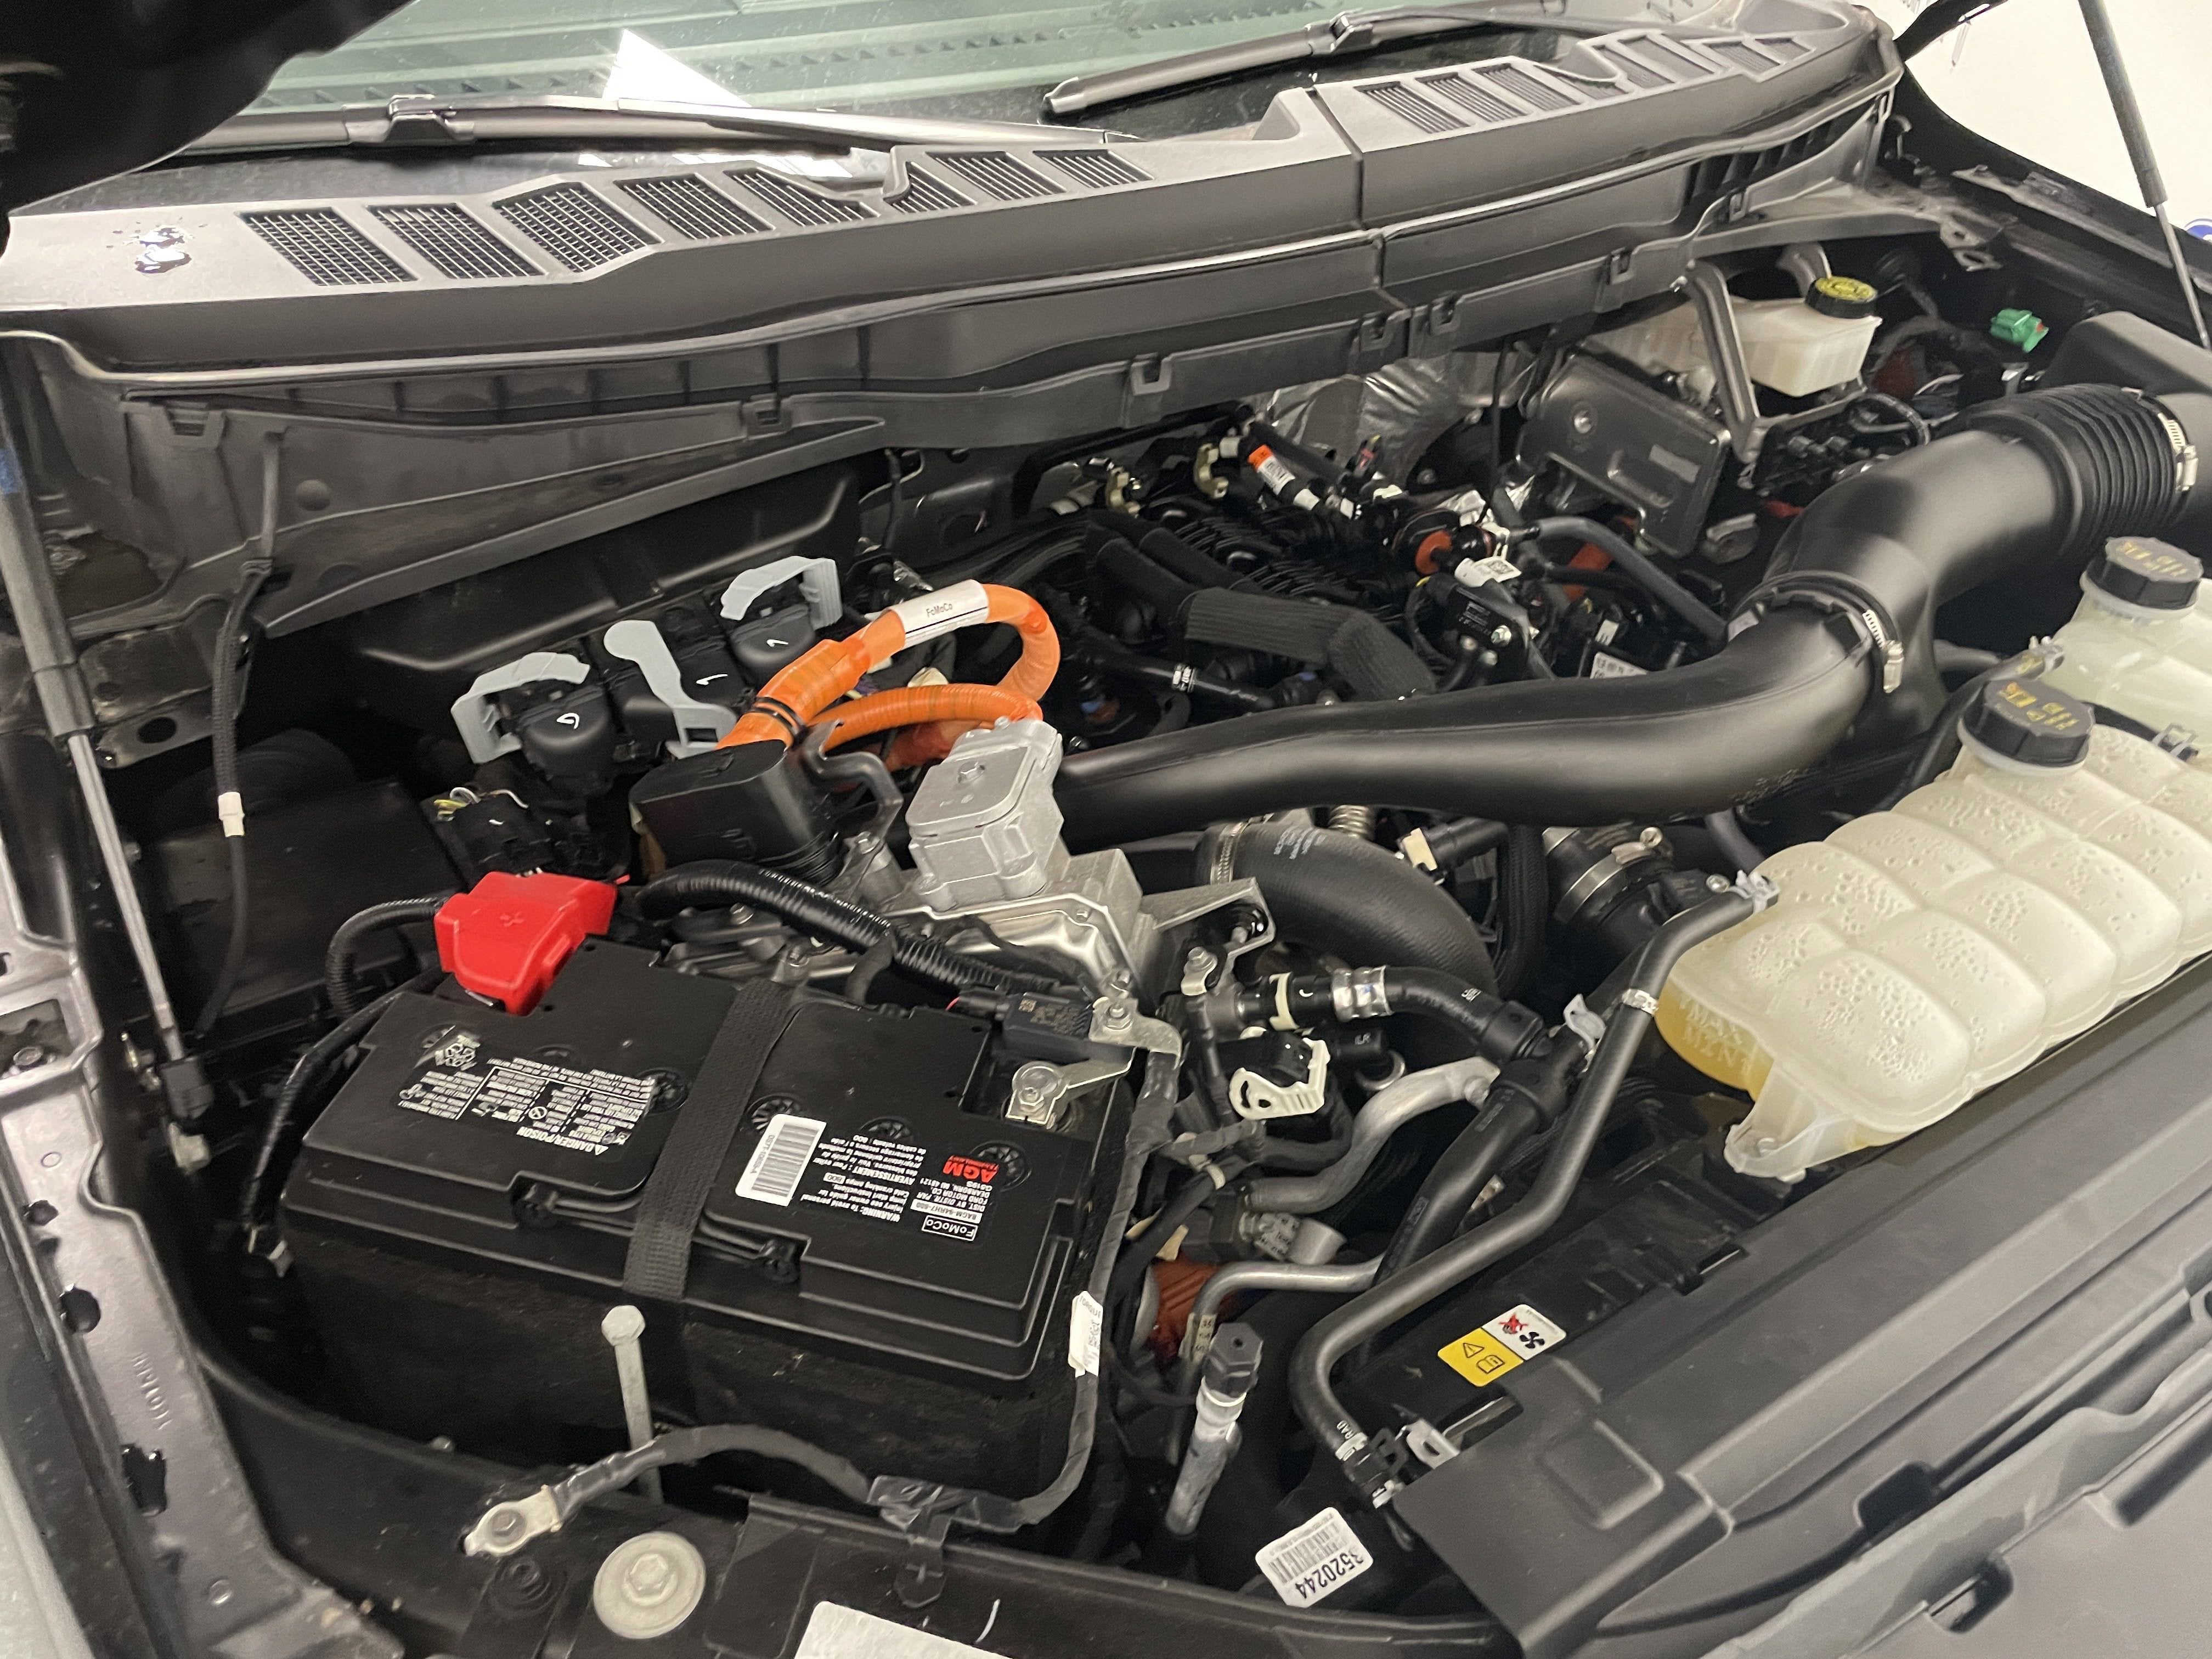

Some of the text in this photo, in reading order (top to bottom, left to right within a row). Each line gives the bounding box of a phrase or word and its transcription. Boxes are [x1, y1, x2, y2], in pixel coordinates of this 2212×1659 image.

[925, 602, 953, 617] FoMoCo
[517, 1127, 594, 1151] DANGER/POISON
[853, 1166, 915, 1184] AVERTISSEMENT
[943, 1161, 996, 1182] AGM
[865, 1181, 893, 1193] cranking
[893, 1189, 909, 1198] Cold
[800, 1194, 831, 1204] personal
[916, 1192, 932, 1200] PAR
[930, 1187, 988, 1205] FORD MOTOR CO.
[934, 1195, 956, 1205] DISTR.
[831, 1200, 850, 1208] avoid
[968, 1203, 985, 1212] DIST.
[860, 1206, 900, 1221] WARNING:
[926, 1219, 974, 1237] FoMoCo
[1336, 1420, 1354, 1438] RAD
[1295, 1546, 1364, 1598] 3520244
